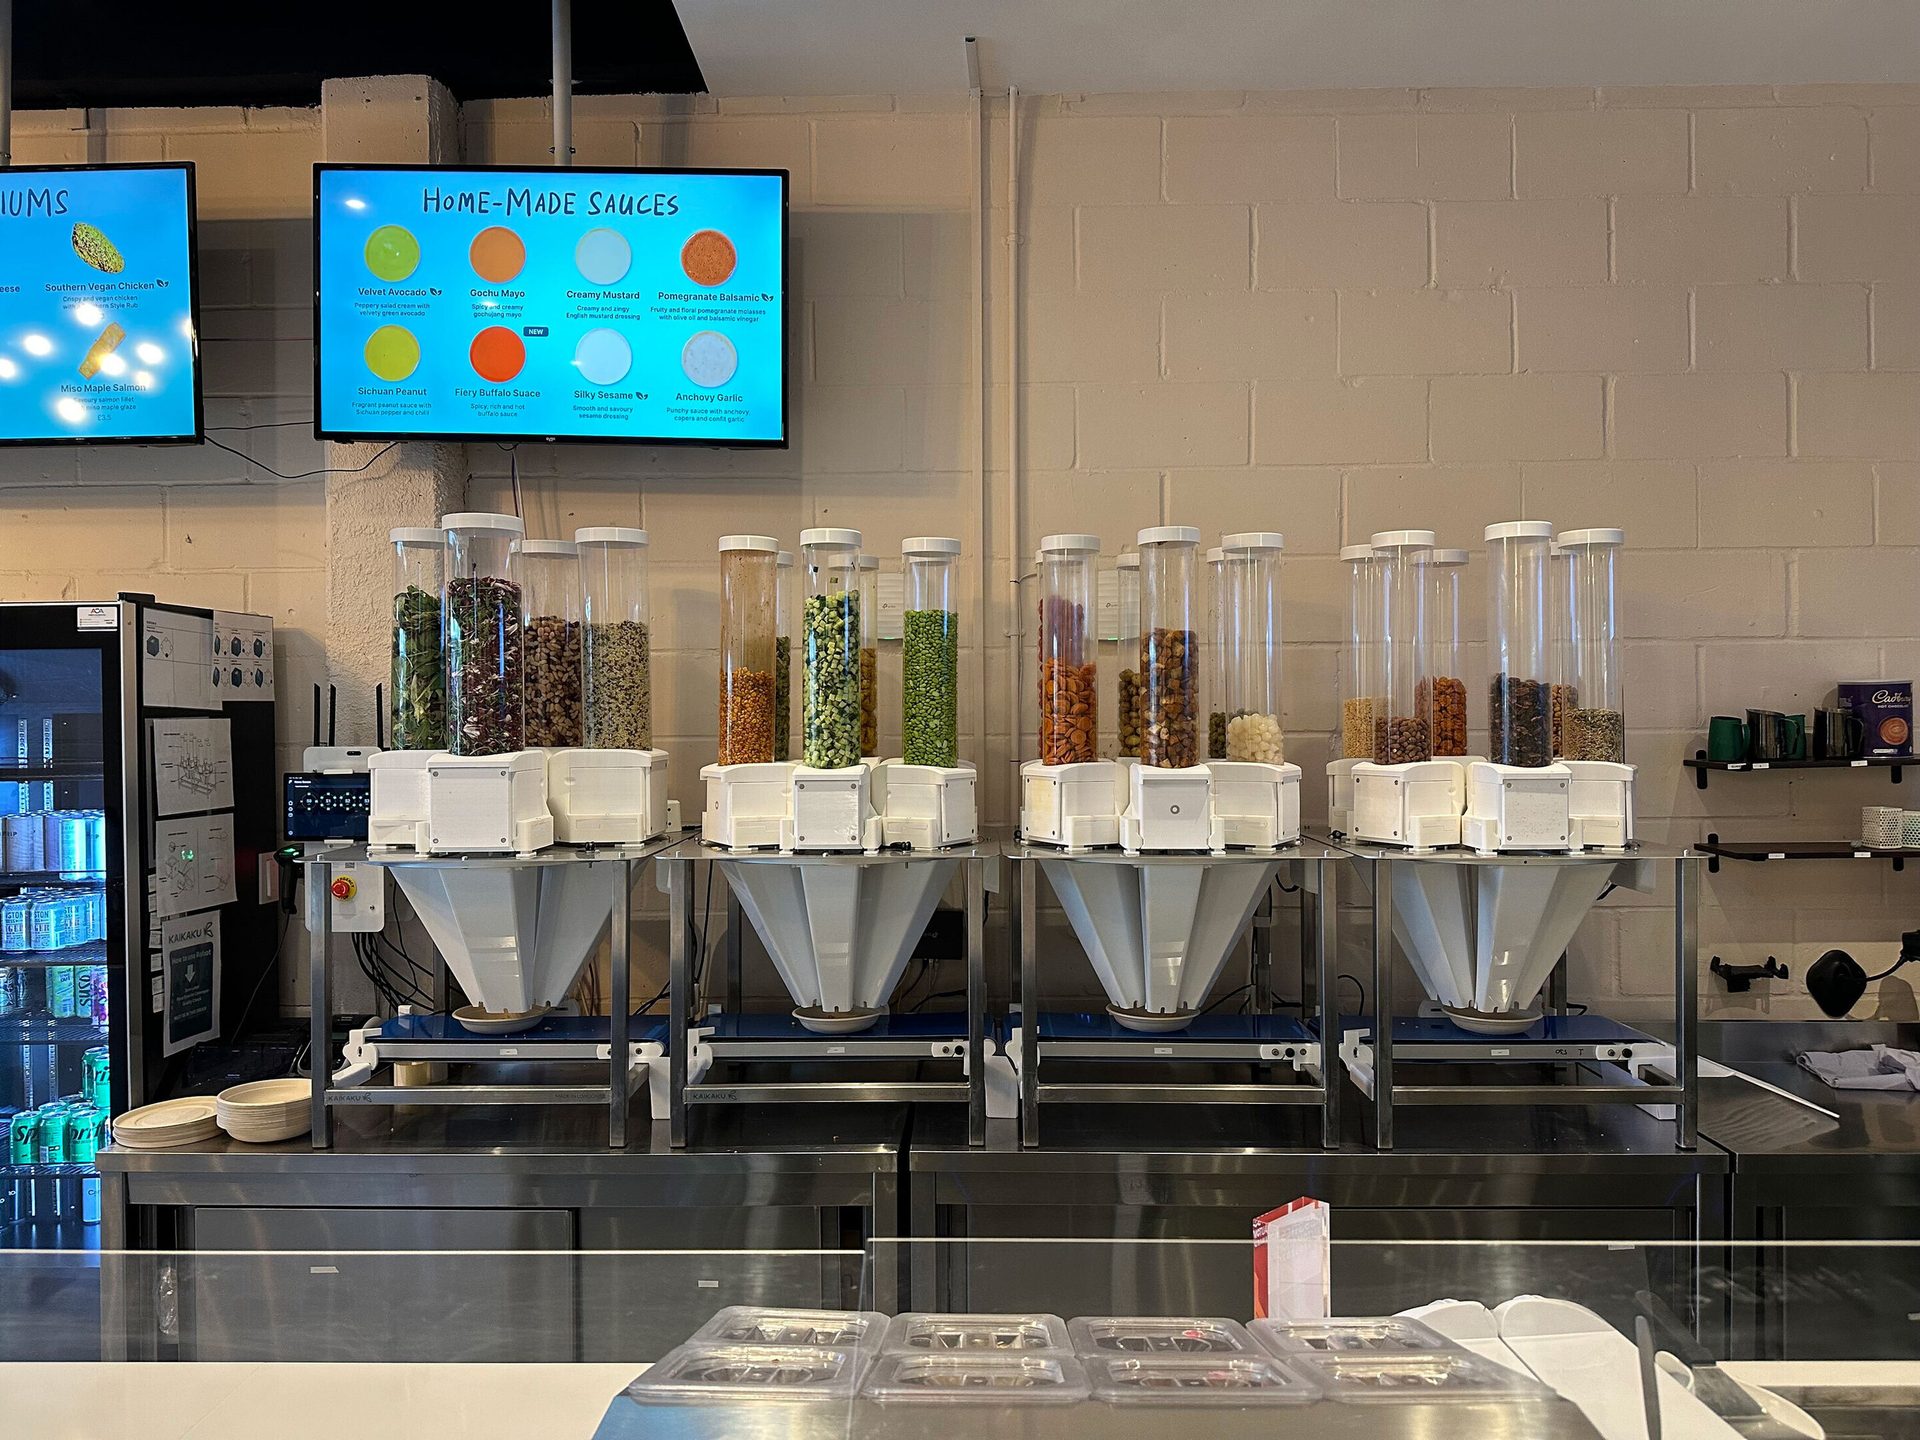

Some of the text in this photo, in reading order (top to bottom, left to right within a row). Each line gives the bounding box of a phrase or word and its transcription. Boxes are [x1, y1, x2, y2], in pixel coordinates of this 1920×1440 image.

[423, 187, 679, 216] HOME-MADE SAUCES
[45, 282, 155, 292] Southern Vegan Chicken
[358, 288, 427, 296] Velvet Avocado
[62, 295, 81, 303] Crispy
[96, 295, 113, 303] vegan
[470, 289, 525, 299] Gochu Mayo
[566, 291, 640, 301] Creamy Mustard
[658, 292, 760, 302] Pomegranate Balsamic
[60, 383, 146, 394] Miso Maple Salmon
[358, 387, 427, 396] Sichuan Peanut
[455, 388, 478, 398] Fiery
[479, 388, 511, 397] Buffalo
[574, 390, 633, 401] Silky Sesame
[676, 393, 743, 403] Anchovy Garlic
[168, 928, 202, 944] KAIKAKU
